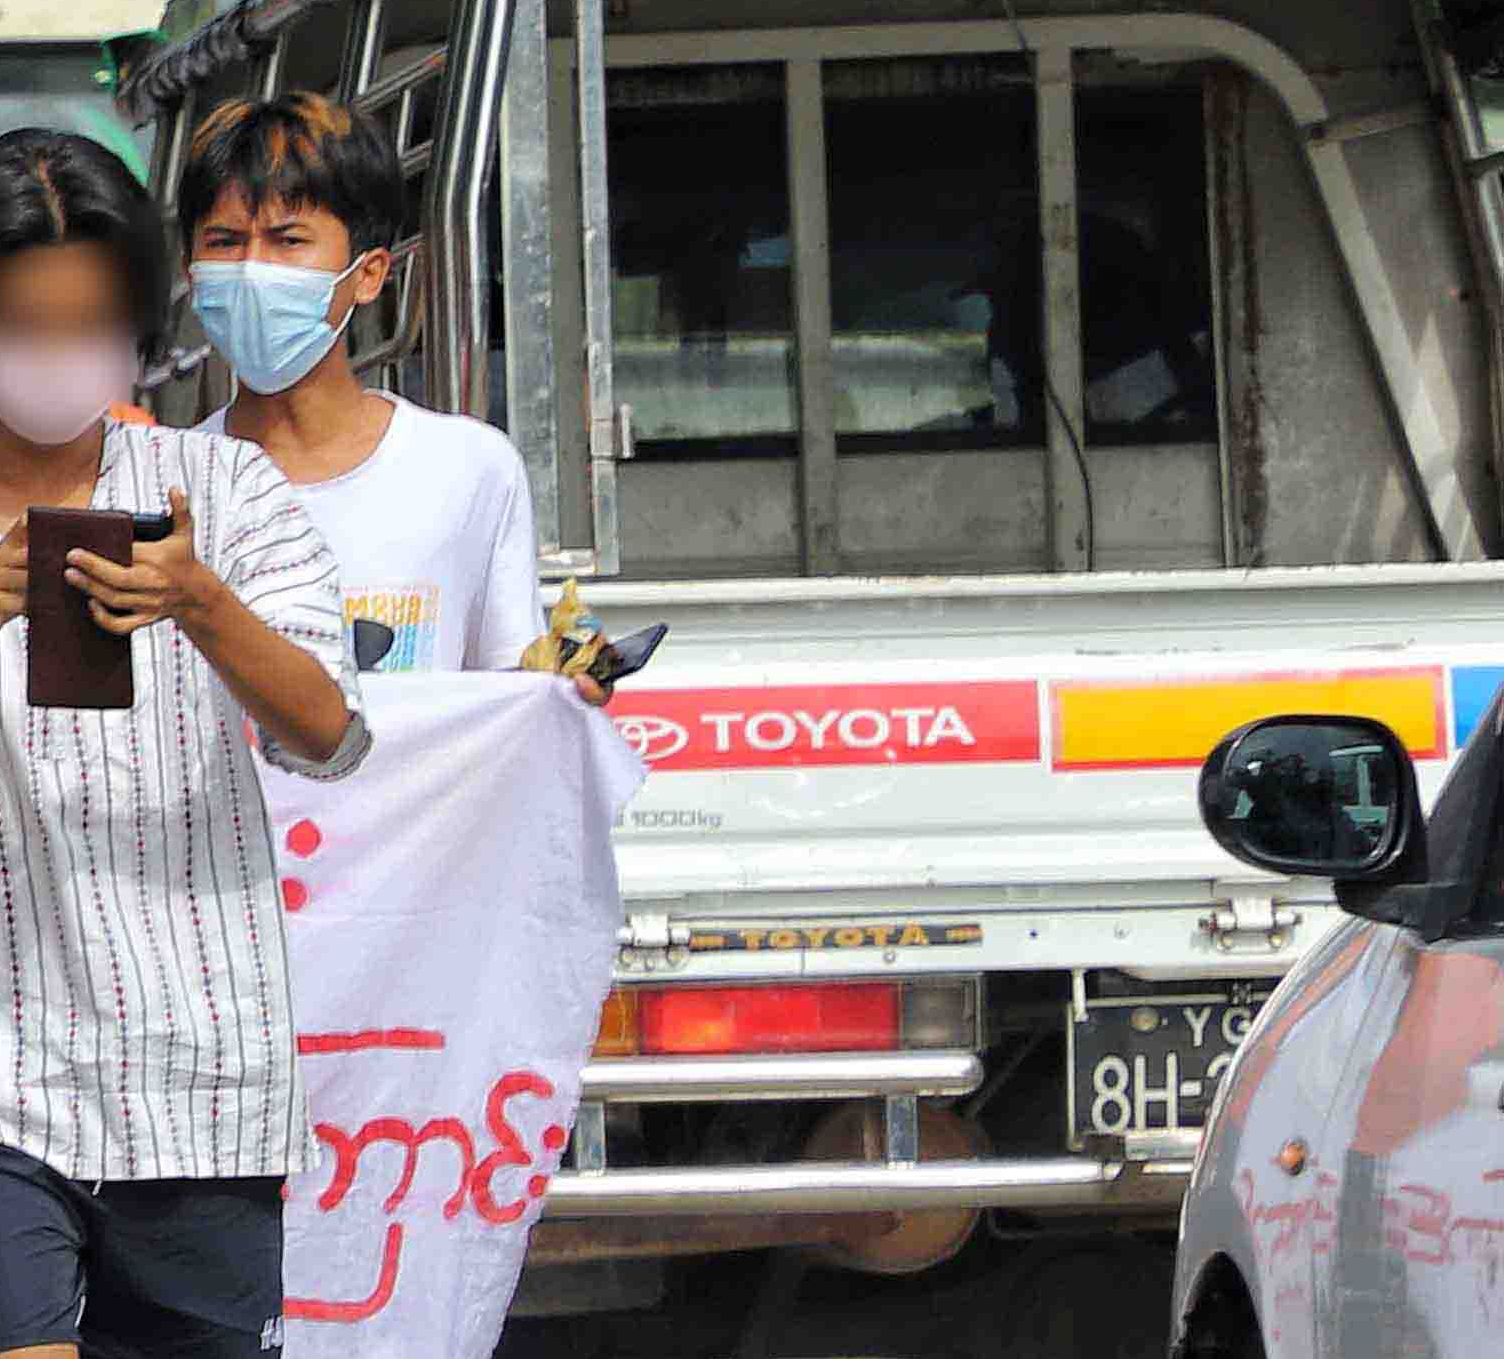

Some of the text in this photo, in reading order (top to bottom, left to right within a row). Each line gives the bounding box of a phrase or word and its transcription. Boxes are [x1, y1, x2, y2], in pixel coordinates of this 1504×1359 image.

[700, 707, 976, 752] TOYOTA
[738, 920, 930, 951] TOYOTA
[1182, 1006, 1253, 1047] YG
